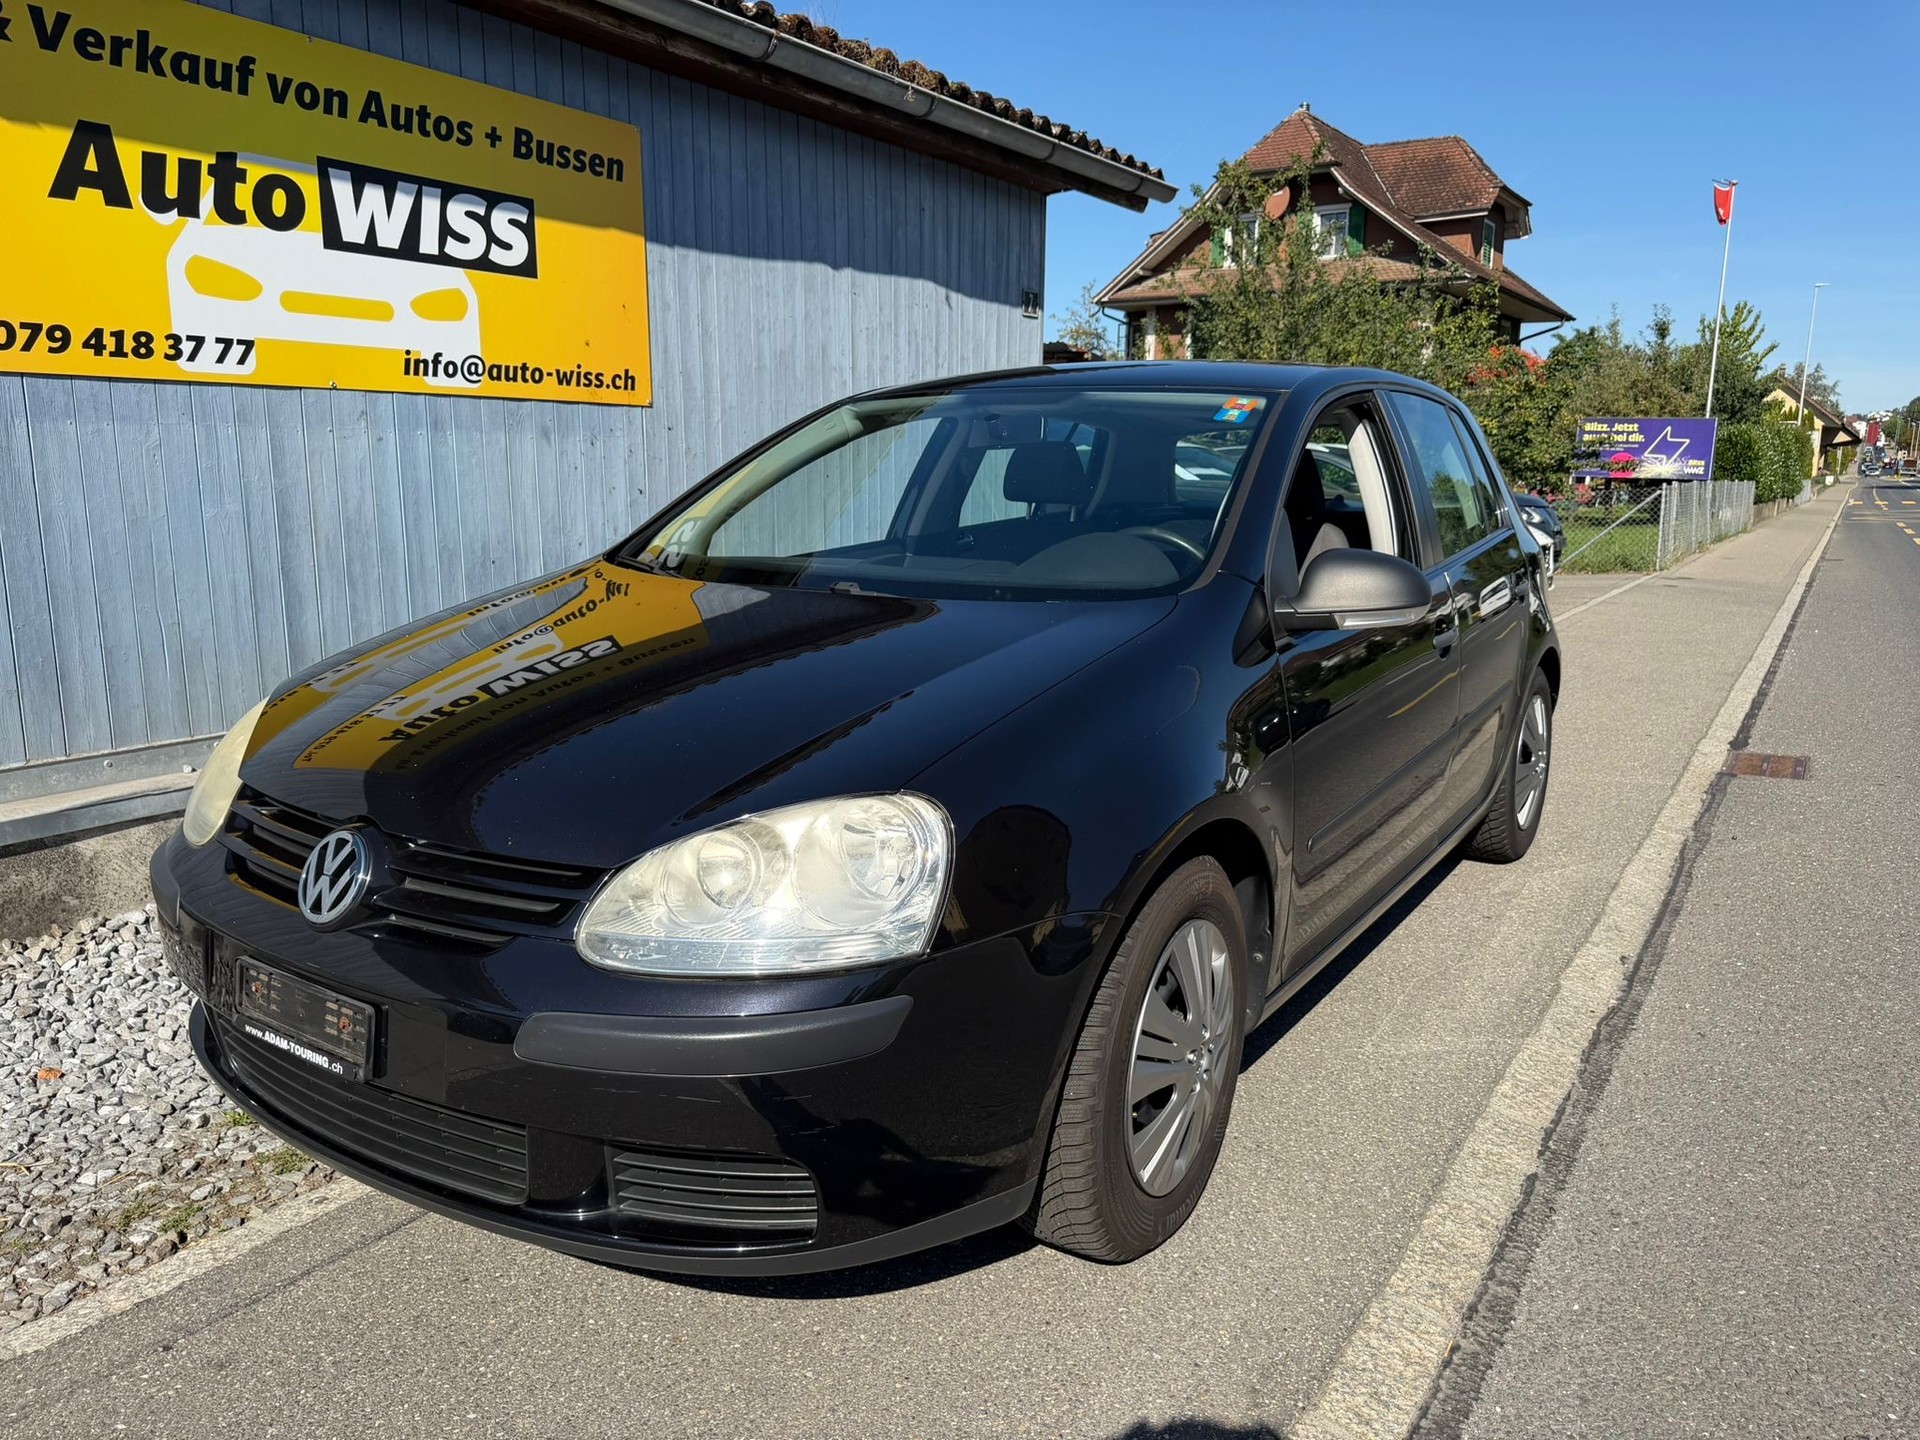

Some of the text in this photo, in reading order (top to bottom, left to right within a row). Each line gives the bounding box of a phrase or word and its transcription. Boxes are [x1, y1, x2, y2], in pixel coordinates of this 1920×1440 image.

[26, 3, 256, 97] Verkauf
[266, 73, 348, 119] von
[358, 91, 473, 148] Autos
[485, 127, 503, 148] +
[513, 127, 625, 182] Bussen
[48, 119, 532, 267] Auto WISS
[0, 319, 256, 366] 079 418 37 77
[403, 349, 636, 392] info@auto-wiss.ch
[1612, 422, 1639, 432] Jetzt
[1628, 433, 1645, 442] dir.
[244, 1023, 344, 1075] www.ADAM-TOURING.ch
